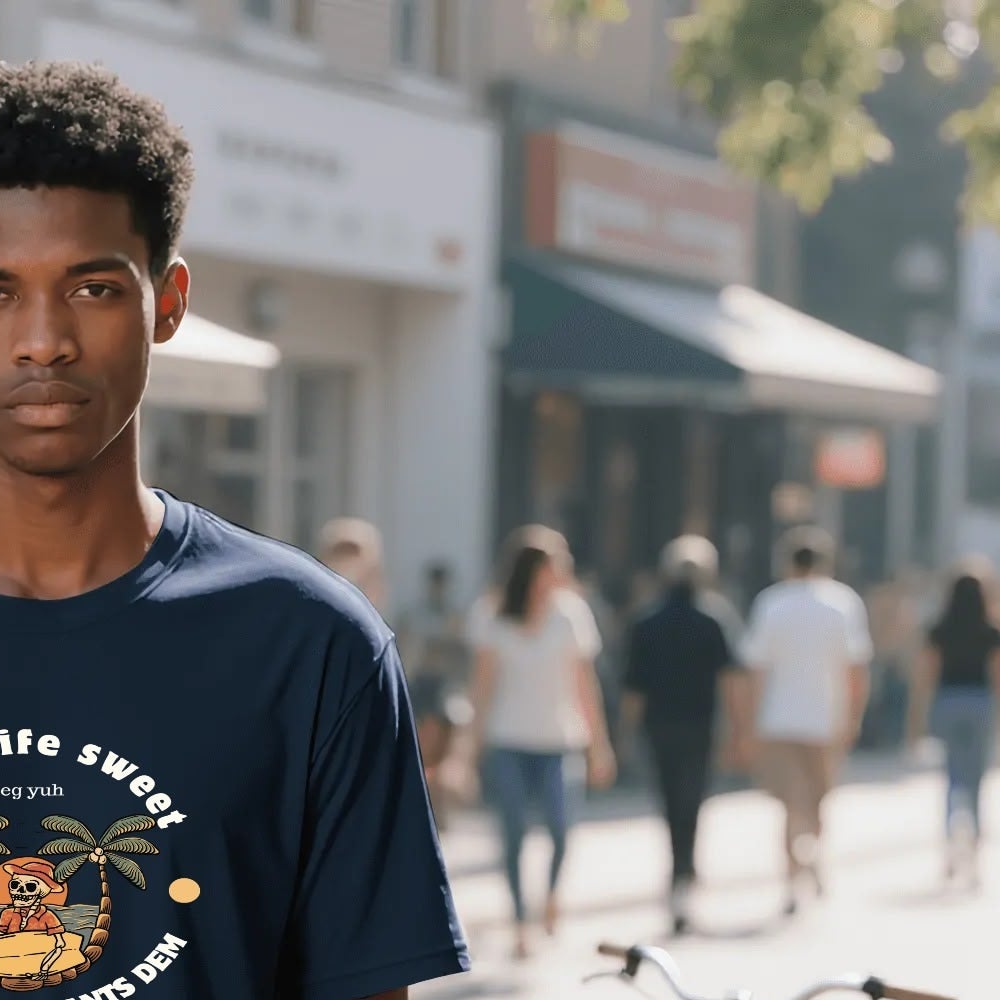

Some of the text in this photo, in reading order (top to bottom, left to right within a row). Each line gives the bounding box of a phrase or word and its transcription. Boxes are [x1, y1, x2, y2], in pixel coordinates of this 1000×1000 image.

[27, 783, 64, 800] yuh
[77, 743, 188, 830] sweet
[131, 932, 188, 985] DEM
